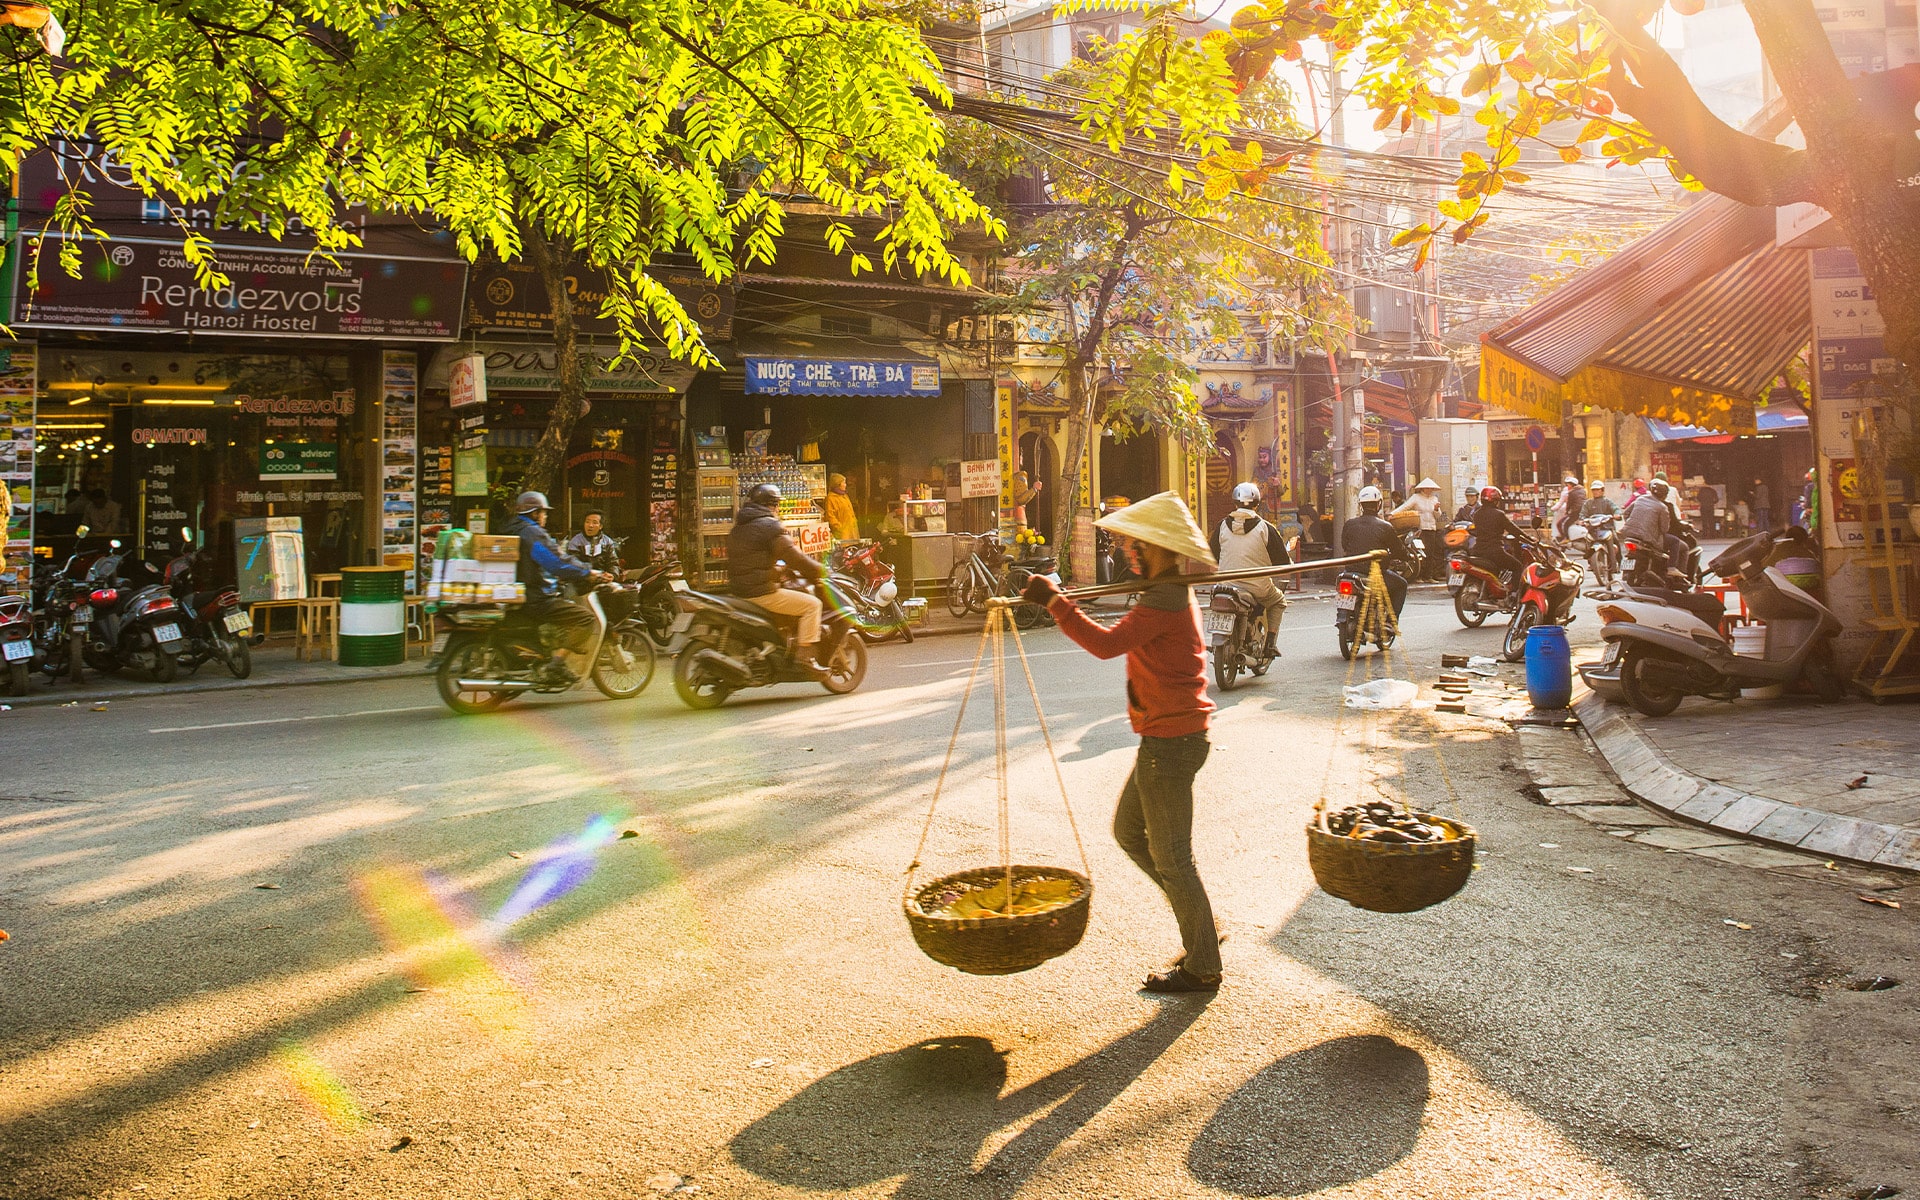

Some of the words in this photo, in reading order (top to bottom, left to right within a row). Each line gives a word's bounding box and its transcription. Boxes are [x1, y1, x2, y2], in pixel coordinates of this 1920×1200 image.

[217, 260, 250, 272] TNHH
[251, 263, 297, 275] ACCOM
[326, 266, 353, 278] NAM
[141, 275, 363, 314] Rendezvous
[183, 310, 246, 329] Hanoi
[252, 313, 317, 331] Hostel
[757, 361, 796, 381] NƯỚC
[805, 361, 834, 381] CHÈ
[850, 362, 878, 382] TRÀ
[885, 364, 905, 382] ĐÁ
[238, 388, 356, 414] Rendezvous
[802, 527, 829, 545] Café
